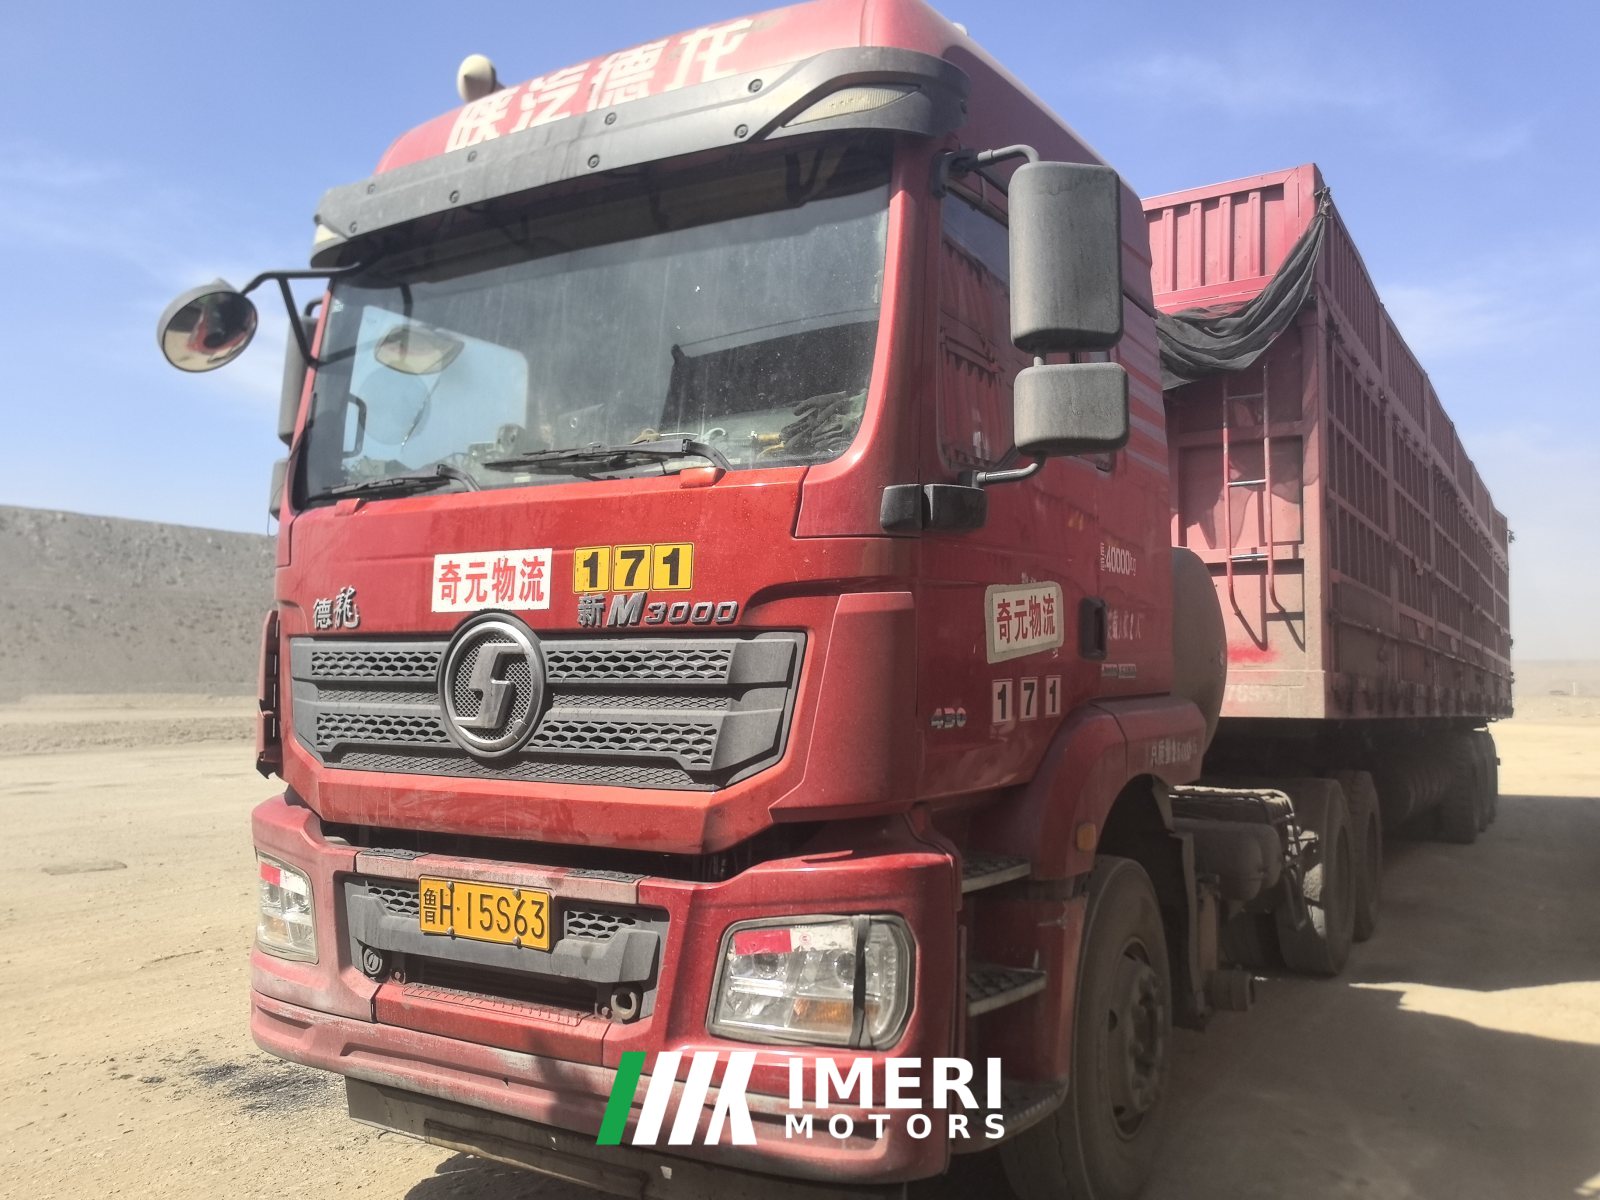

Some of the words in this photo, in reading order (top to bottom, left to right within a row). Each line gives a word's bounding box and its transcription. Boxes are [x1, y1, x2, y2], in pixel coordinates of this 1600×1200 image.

[438, 555, 546, 604] 奇元物流
[582, 547, 683, 589] 171
[996, 593, 1056, 644] 奇元物流
